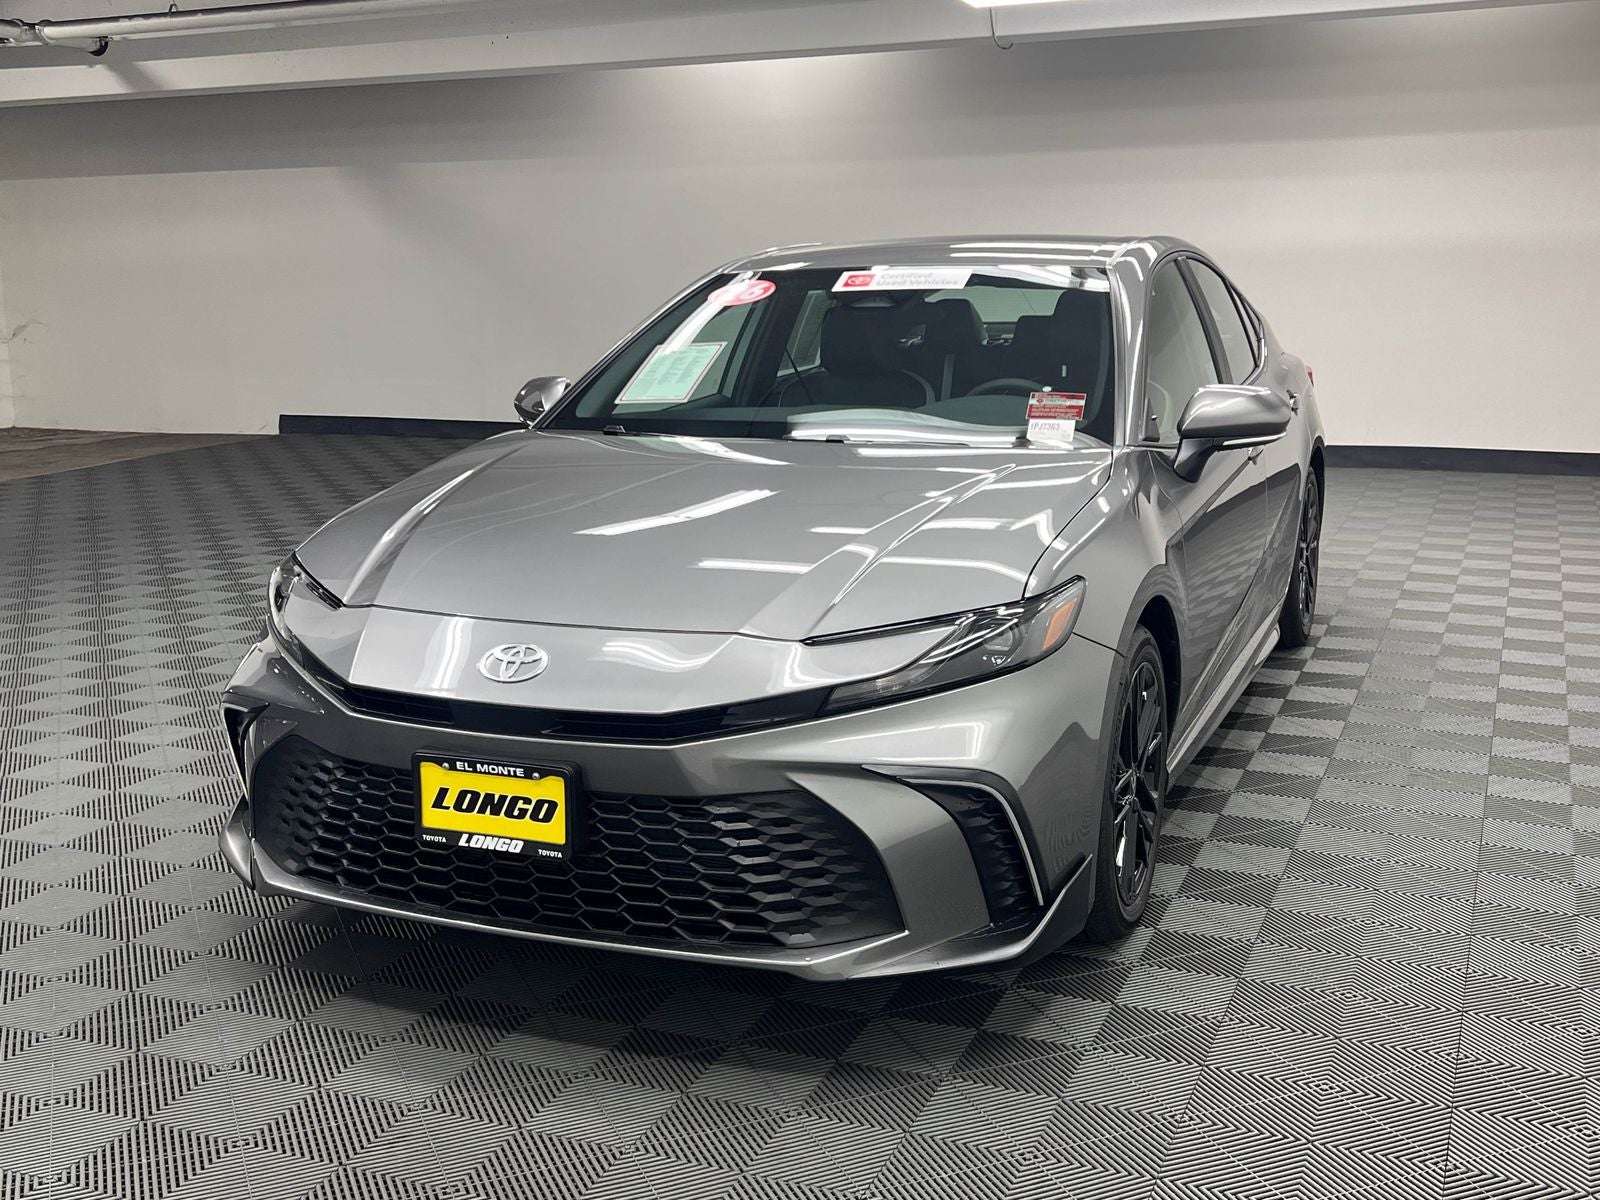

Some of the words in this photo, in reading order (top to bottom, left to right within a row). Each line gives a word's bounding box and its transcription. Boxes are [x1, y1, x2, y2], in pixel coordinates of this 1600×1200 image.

[456, 761, 473, 771] EL
[476, 764, 525, 777] MONTE
[431, 786, 559, 824] LONGO
[422, 834, 447, 843] TOYOTA
[458, 833, 524, 854] LONGO
[538, 849, 563, 858] TOYOTA
